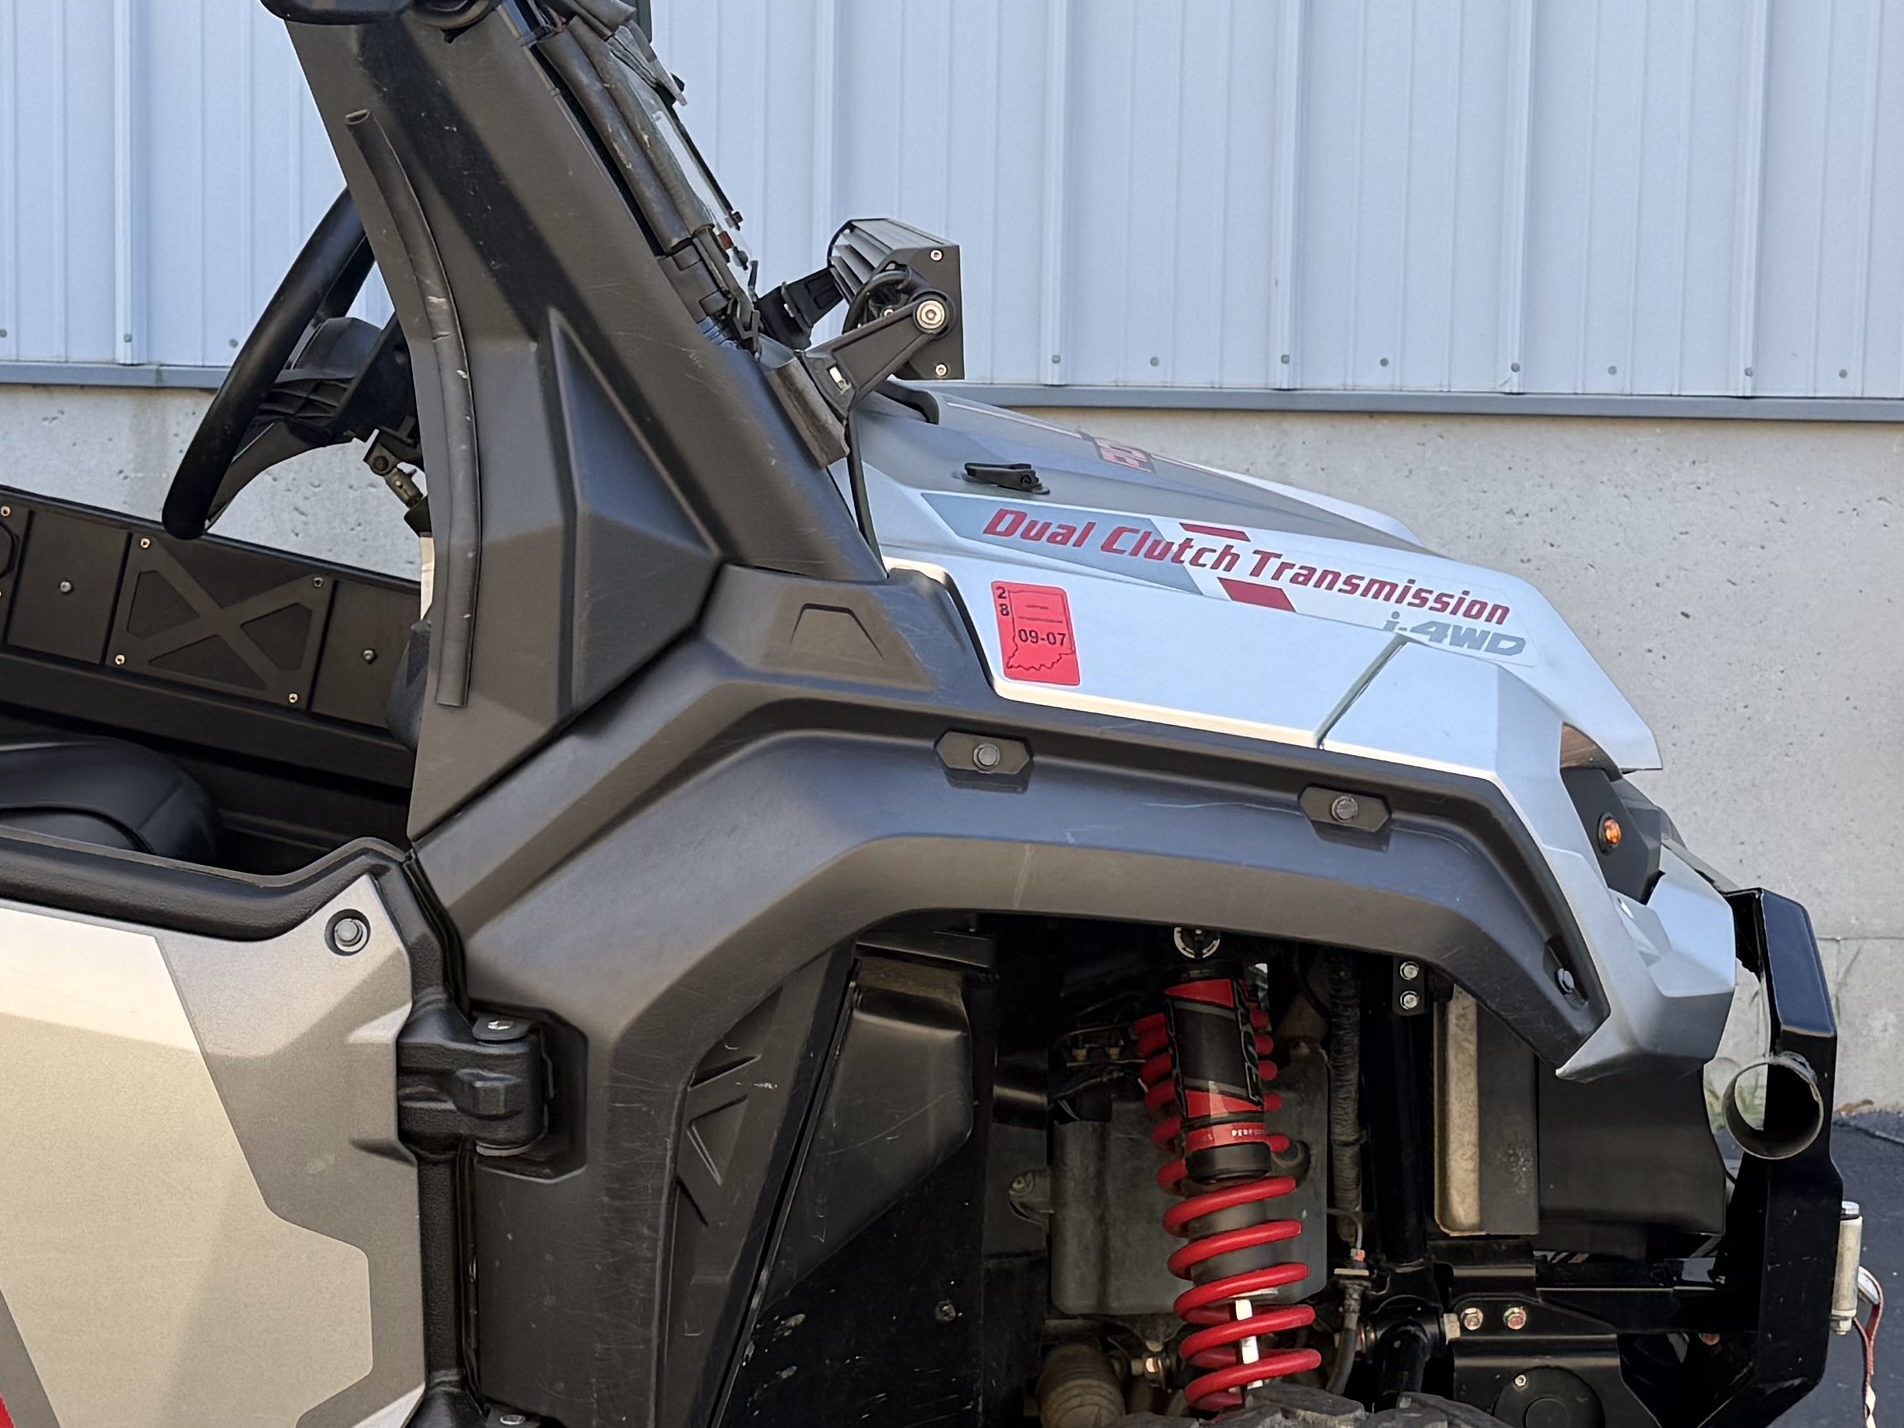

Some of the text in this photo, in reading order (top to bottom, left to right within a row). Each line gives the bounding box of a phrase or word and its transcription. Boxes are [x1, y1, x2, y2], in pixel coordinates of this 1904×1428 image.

[982, 507, 1511, 626] Dual Clutch Transmission
[1017, 628, 1067, 647] 09-07
[1382, 610, 1527, 657] i-4WD
